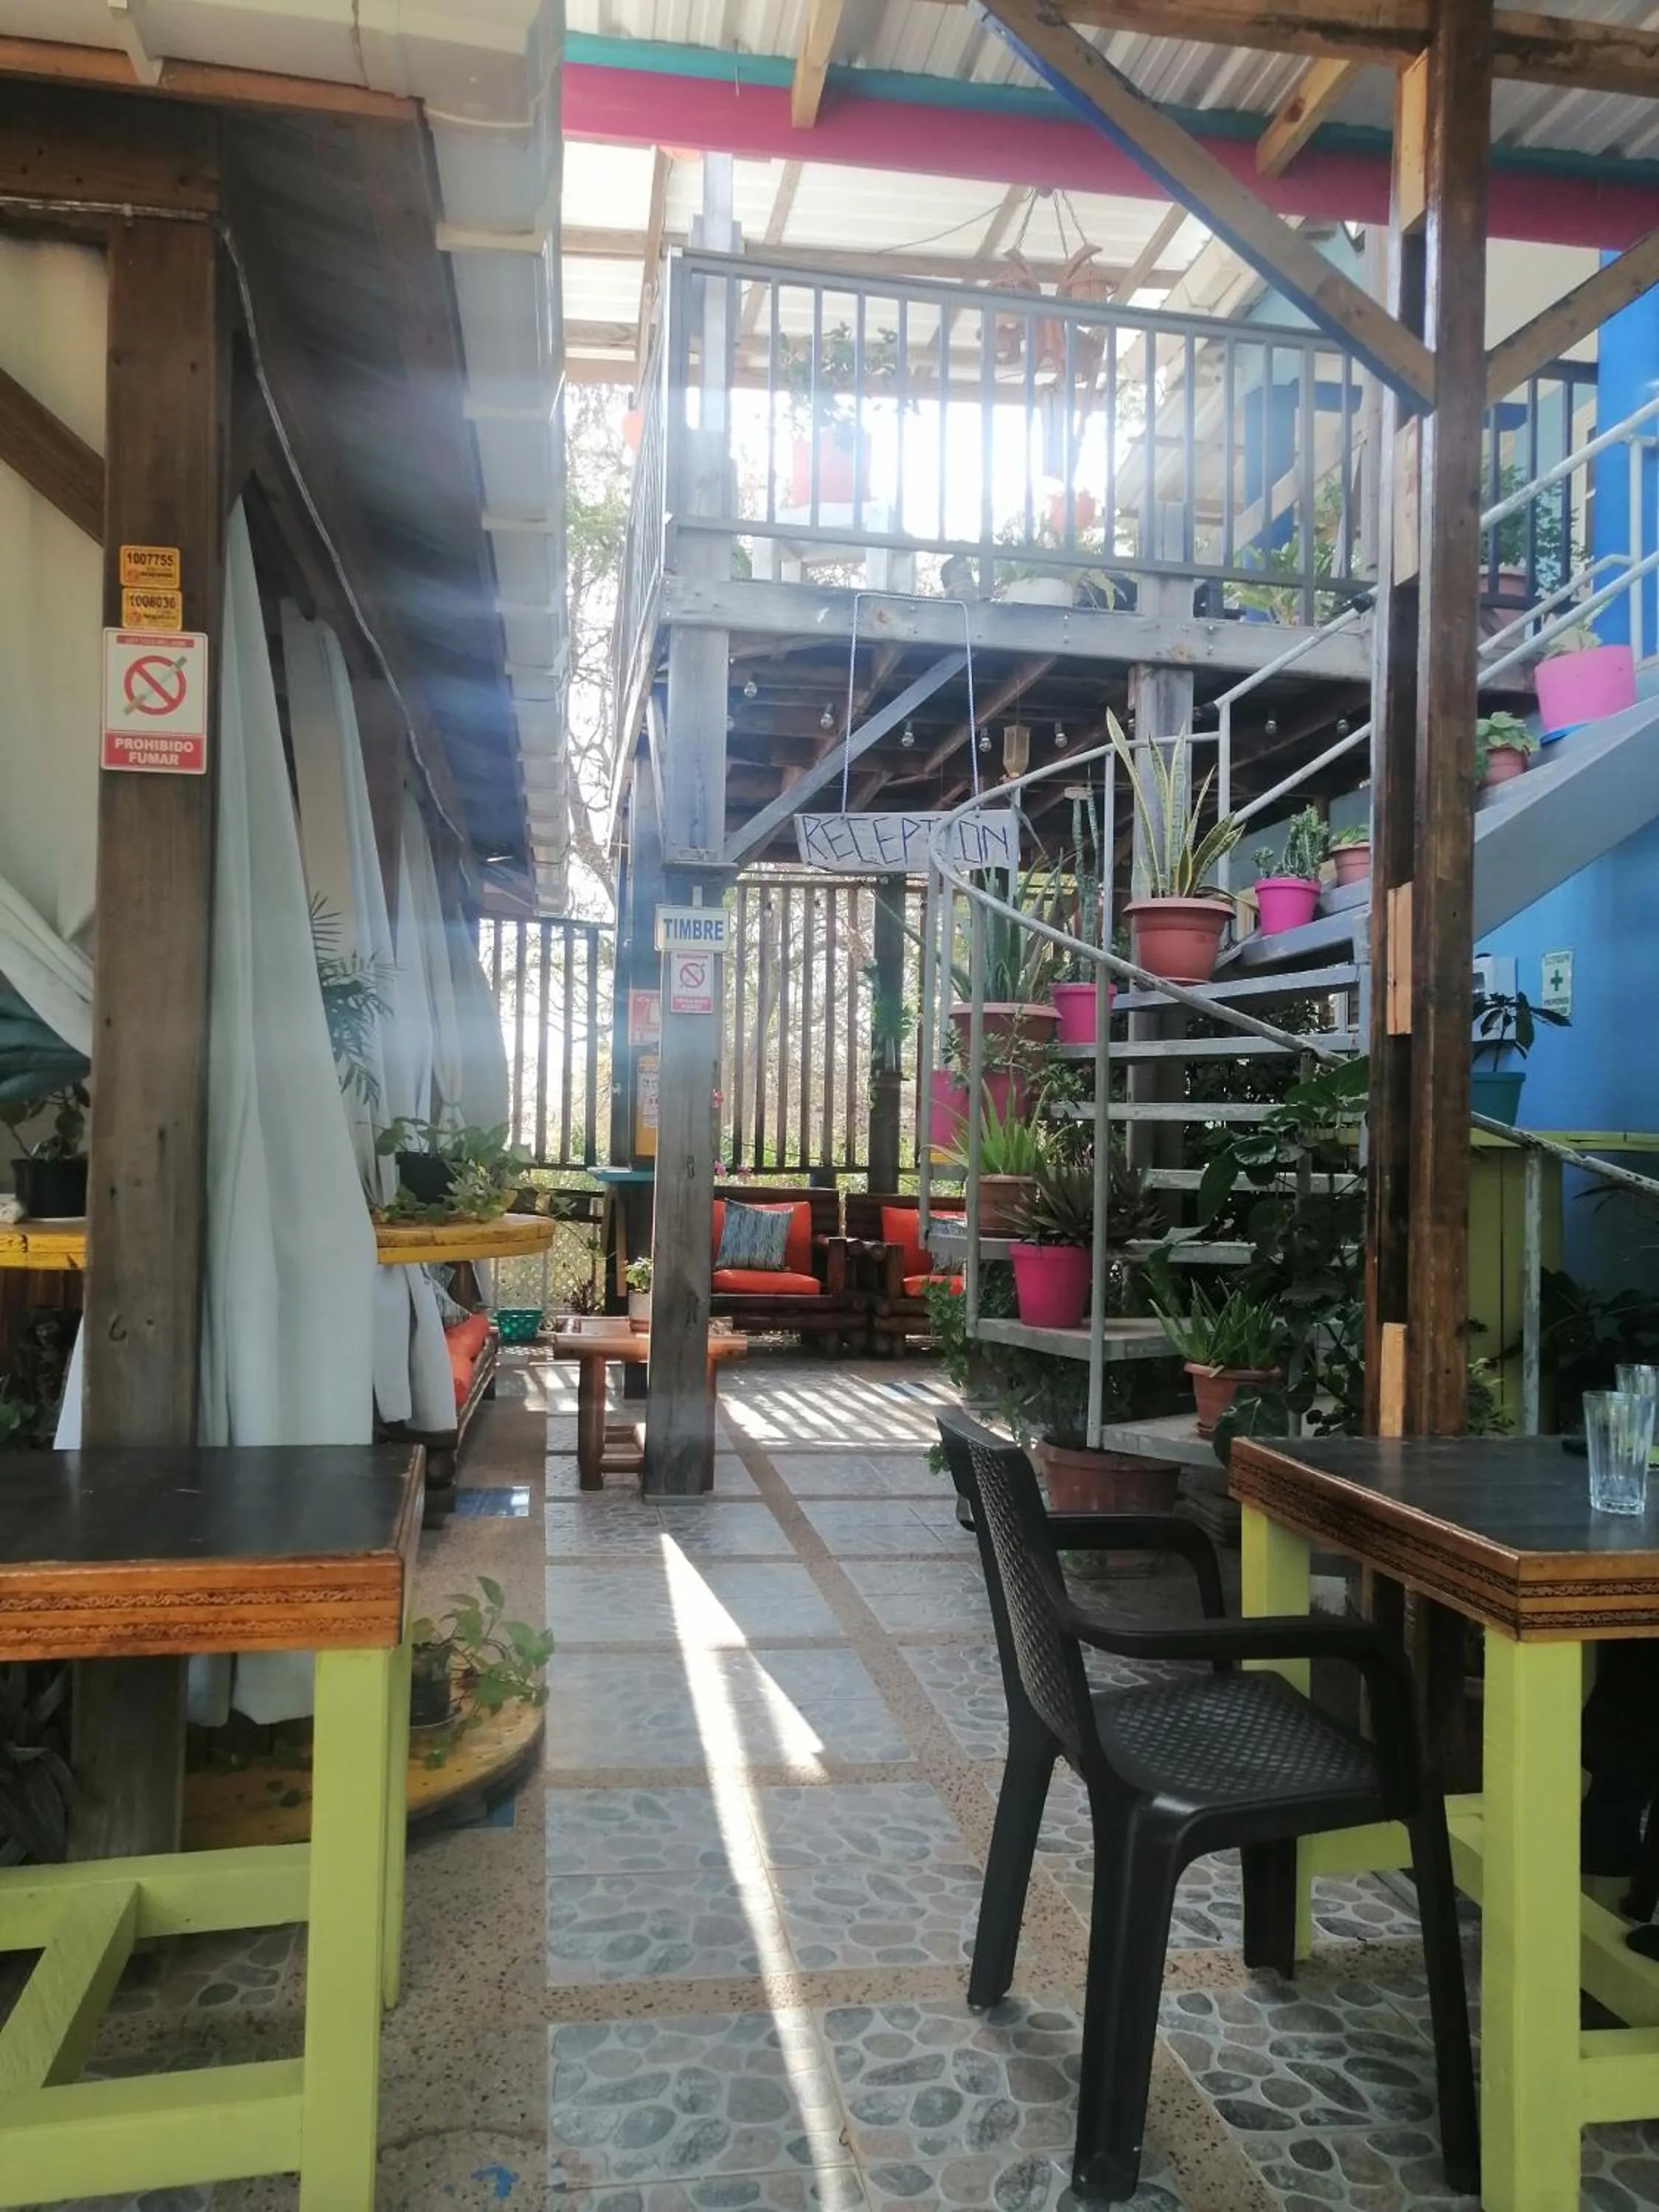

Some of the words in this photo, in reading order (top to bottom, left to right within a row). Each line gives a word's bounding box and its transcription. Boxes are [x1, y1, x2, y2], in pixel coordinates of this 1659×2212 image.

[127, 552, 174, 567] 1007755
[115, 737, 194, 753] PROHIBIDO
[128, 751, 180, 766] FUMAR
[801, 815, 1009, 866] RECEPTON
[663, 918, 724, 941] TIMBRE
